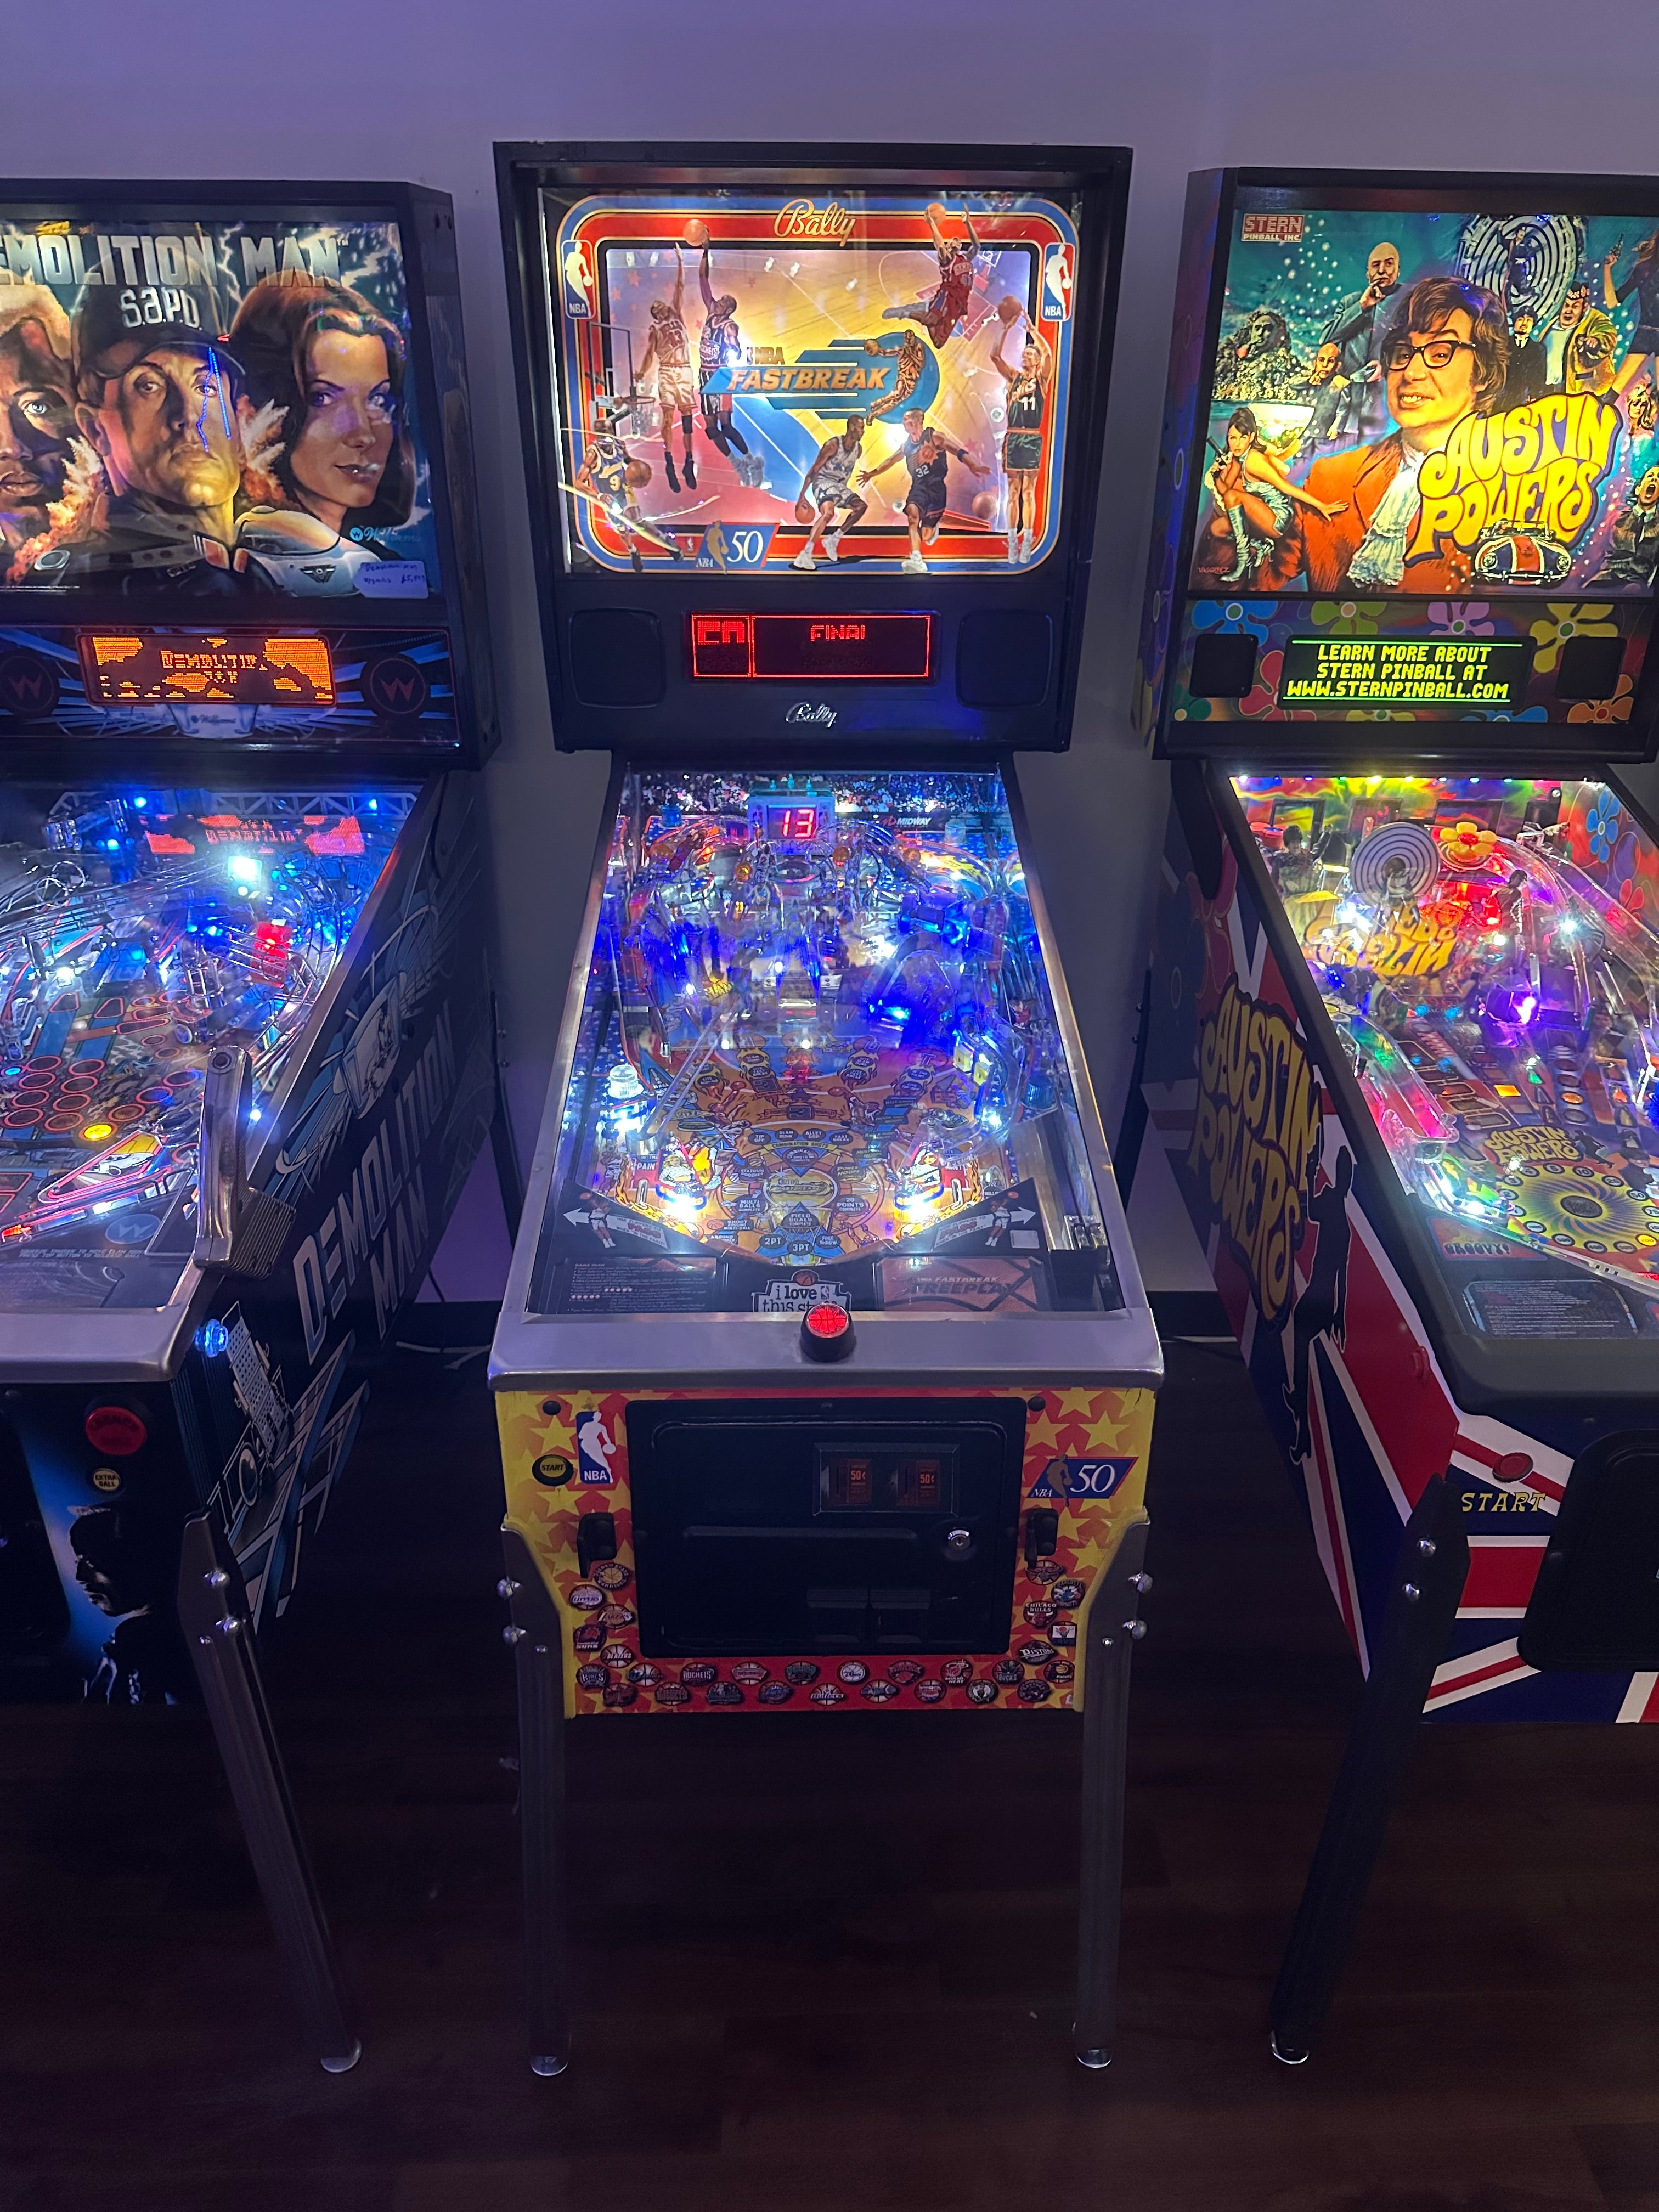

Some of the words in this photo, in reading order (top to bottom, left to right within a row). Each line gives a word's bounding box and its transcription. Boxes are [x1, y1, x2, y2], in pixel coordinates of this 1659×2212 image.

[774, 199, 856, 247] Bally
[1245, 216, 1302, 233] STERN
[0, 235, 218, 286] MOLITION
[569, 302, 586, 314] NBA
[1045, 306, 1062, 317] NBA
[755, 347, 785, 365] NBA
[726, 368, 890, 391] FASTBREAK
[1022, 396, 1036, 411] 11
[1420, 393, 1616, 498] AUSTIN
[915, 465, 930, 478] 32
[610, 475, 621, 492] 9
[1407, 459, 1601, 561] POWERS
[727, 530, 763, 563] 50
[696, 557, 714, 568] NBA
[1318, 644, 1375, 661] LEARN
[1380, 645, 1429, 662] MORE
[1434, 646, 1492, 663] ABOUT
[1317, 663, 1375, 679] STERN
[1381, 663, 1455, 680] PINBALL
[1462, 664, 1488, 680] AT
[1287, 680, 1509, 698] WWW.STERNPINBALL.COM
[786, 702, 837, 728] Bally
[782, 808, 815, 838] 13
[896, 817, 932, 825] MIDWAY
[1202, 984, 1321, 1192] AUSTIN
[1485, 1127, 1567, 1150] AUSTIN
[370, 1163, 429, 1341] MAN
[1444, 1242, 1510, 1255] GROOVY!
[784, 1285, 817, 1300] love
[541, 1464, 565, 1472] START
[584, 1470, 607, 1481] NBA
[1070, 1464, 1115, 1493] 50
[1031, 1488, 1053, 1498] NBA
[1462, 1492, 1547, 1514] START
[582, 1672, 604, 1682] KINGS
[683, 1670, 713, 1681] ROCKETS
[998, 1673, 1018, 1681] BUCKS
